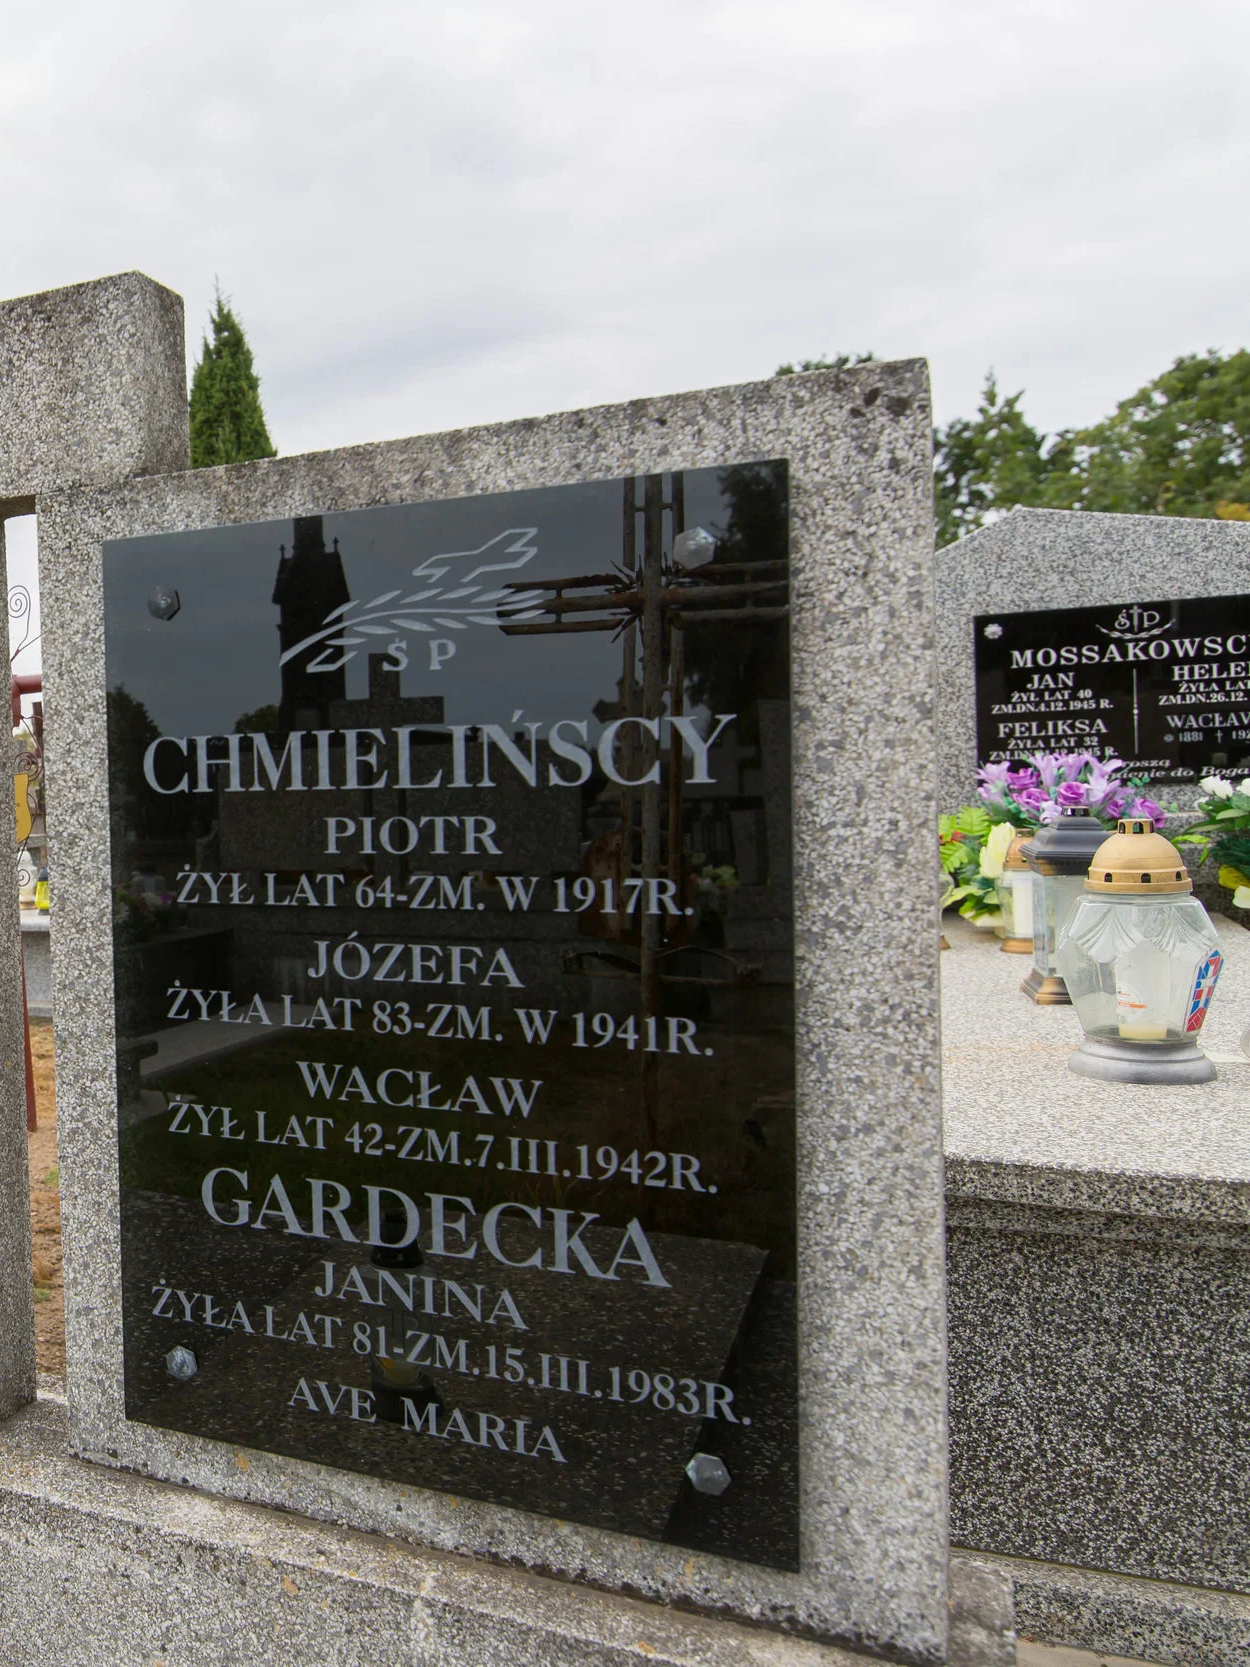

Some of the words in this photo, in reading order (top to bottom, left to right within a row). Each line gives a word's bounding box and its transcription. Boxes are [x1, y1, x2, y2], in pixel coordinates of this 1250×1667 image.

[429, 639, 457, 670] P
[1010, 635, 1250, 669] MOSSAKOWSC
[1171, 661, 1250, 681] HELE
[1026, 672, 1075, 690] JAN
[1044, 690, 1071, 701] LAT
[1077, 688, 1092, 699] 40
[1100, 698, 1114, 709] R.
[998, 718, 1108, 738] FELIKSA
[1050, 737, 1077, 748] LAT
[1083, 736, 1098, 746] 32
[143, 709, 737, 794] CHMIELIŃSCY
[1171, 767, 1194, 778] do
[1201, 766, 1250, 779] Boga
[325, 816, 503, 855] PIOTR
[176, 864, 254, 905] ŻYŁ
[265, 873, 344, 906] LAT
[355, 875, 484, 910] 64-ZM.
[496, 876, 539, 911] W
[554, 877, 693, 916] 1917R.
[307, 932, 524, 988] JÓZEFA
[167, 979, 273, 1025] ŻYŁA
[282, 994, 362, 1031] LAT
[373, 1000, 503, 1041] 83-ZM.
[514, 1008, 557, 1043] W
[572, 1012, 713, 1056] 1941R.
[296, 1061, 543, 1119] WACŁAW
[168, 1094, 245, 1140] ŻYŁ
[256, 1111, 334, 1149] LAT
[201, 1166, 673, 1288] GARDECKA
[151, 1278, 255, 1333] ŻYŁA
[264, 1305, 342, 1348] LAT
[314, 1261, 530, 1330] JANINA
[287, 1377, 377, 1423] AVE
[401, 1397, 567, 1463] MARIA
